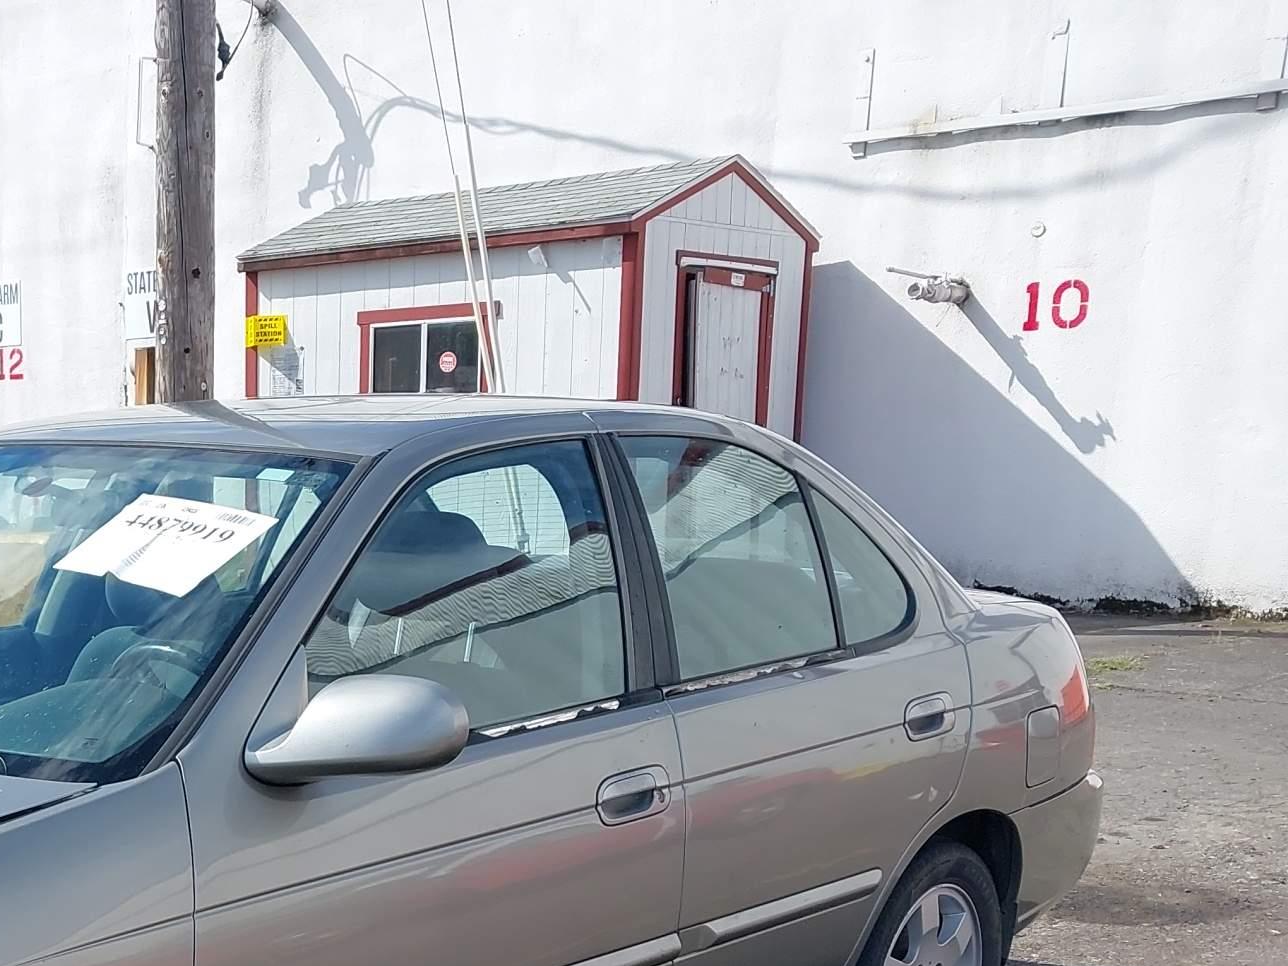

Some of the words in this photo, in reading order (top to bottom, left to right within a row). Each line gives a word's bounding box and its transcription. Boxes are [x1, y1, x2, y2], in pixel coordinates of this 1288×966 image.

[1022, 279, 1090, 332] 10
[255, 330, 282, 338] STATION
[259, 322, 278, 330] SPILL
[125, 513, 236, 543] 44879919
